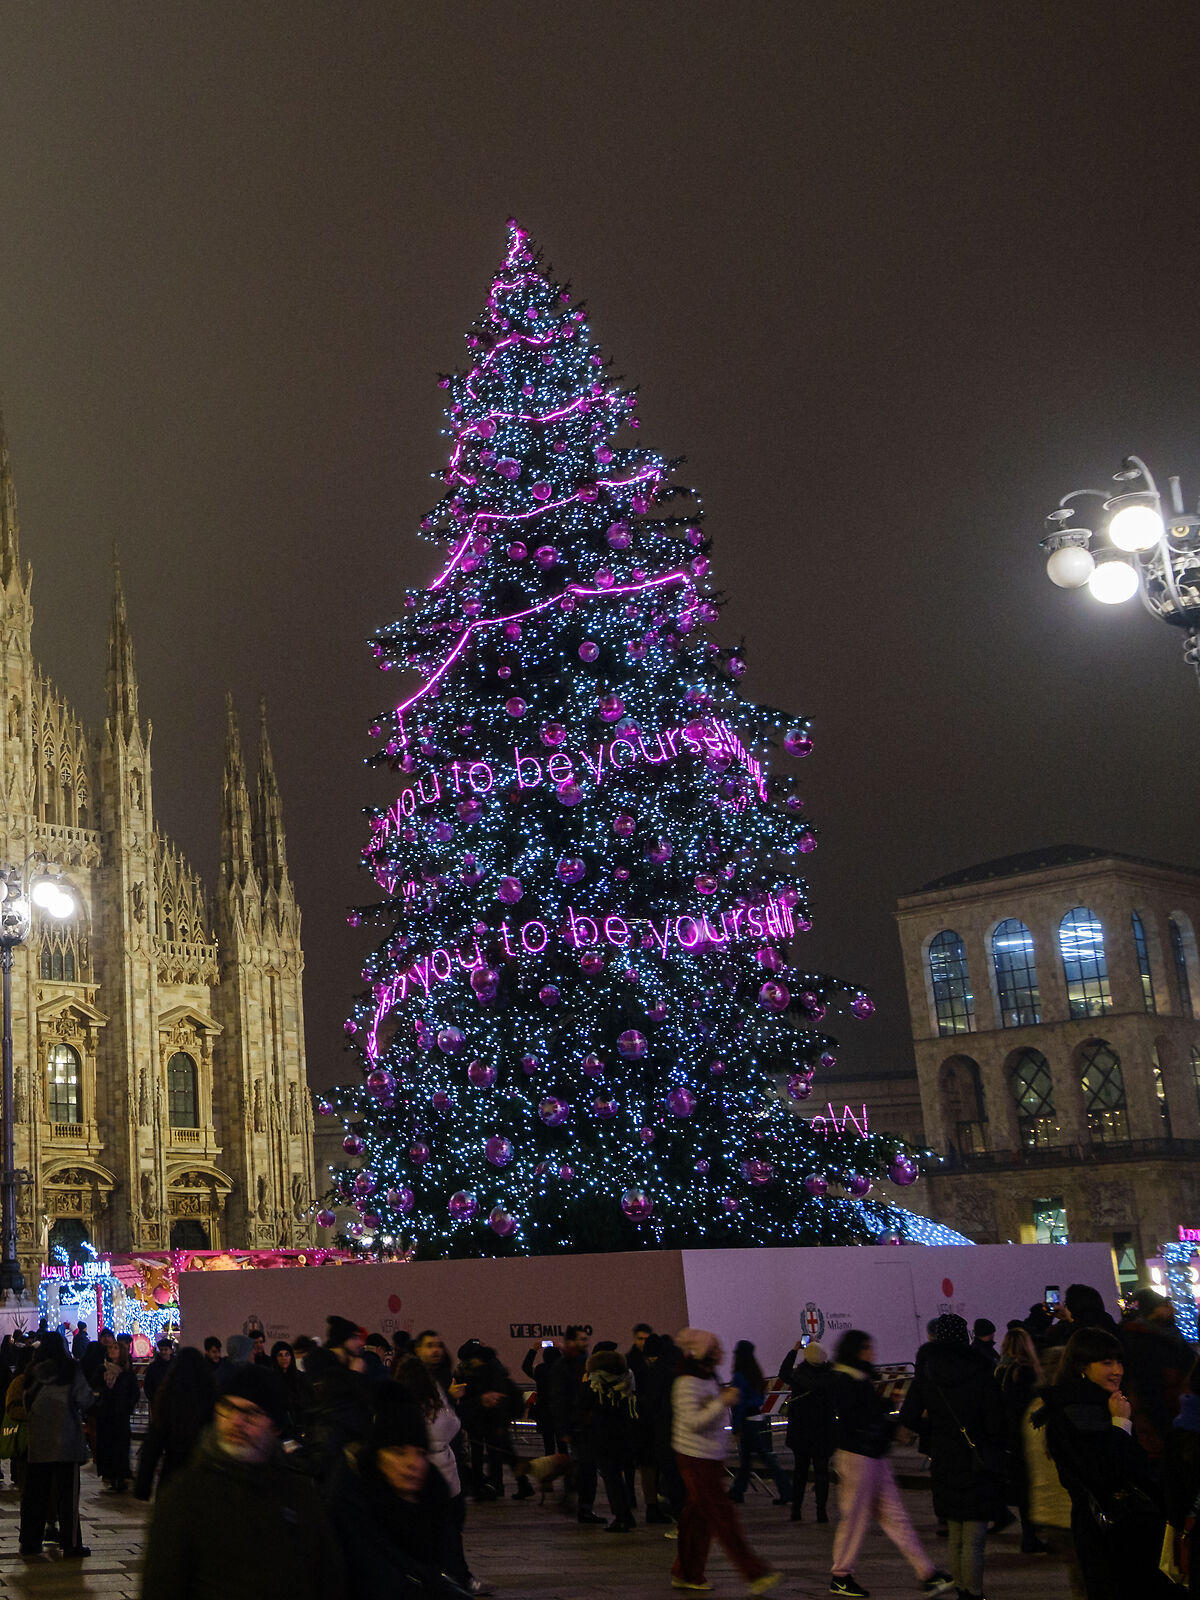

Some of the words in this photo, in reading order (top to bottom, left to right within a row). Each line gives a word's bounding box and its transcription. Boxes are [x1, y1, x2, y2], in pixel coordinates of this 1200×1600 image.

[390, 772, 441, 836] you
[452, 760, 493, 793] to
[514, 746, 572, 789] be
[413, 935, 482, 997] you
[500, 919, 548, 956] to
[567, 906, 629, 947] be
[827, 1320, 853, 1330] Milano
